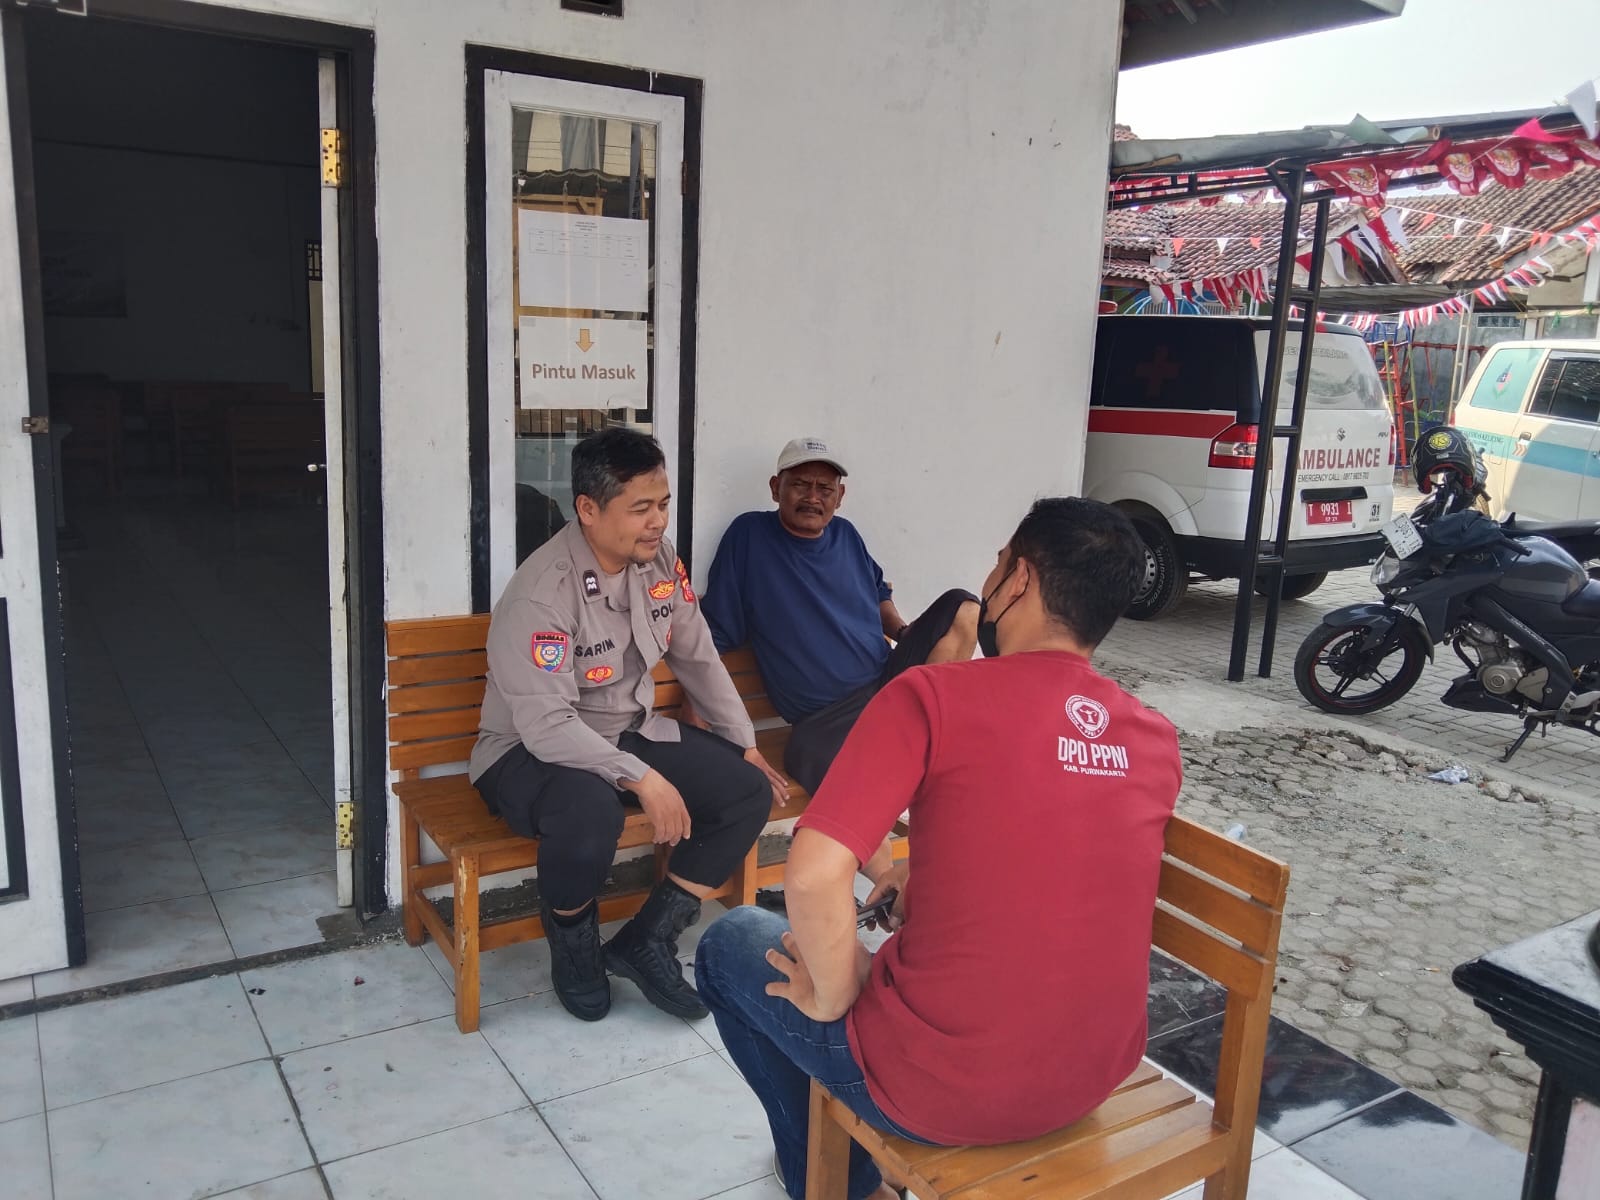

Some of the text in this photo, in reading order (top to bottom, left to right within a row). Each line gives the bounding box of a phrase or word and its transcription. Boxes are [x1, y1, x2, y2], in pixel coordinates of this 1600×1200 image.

[532, 363, 636, 380] Pintu Masuk
[1298, 474, 1327, 482] EMERGENCY
[1308, 503, 1314, 517] T
[1321, 502, 1340, 515] 9931
[1371, 503, 1380, 516] 31
[574, 638, 616, 657] SARIM
[1058, 735, 1129, 770] DPD PPNI
[1063, 764, 1127, 778] KAB. PURWAKARTA
